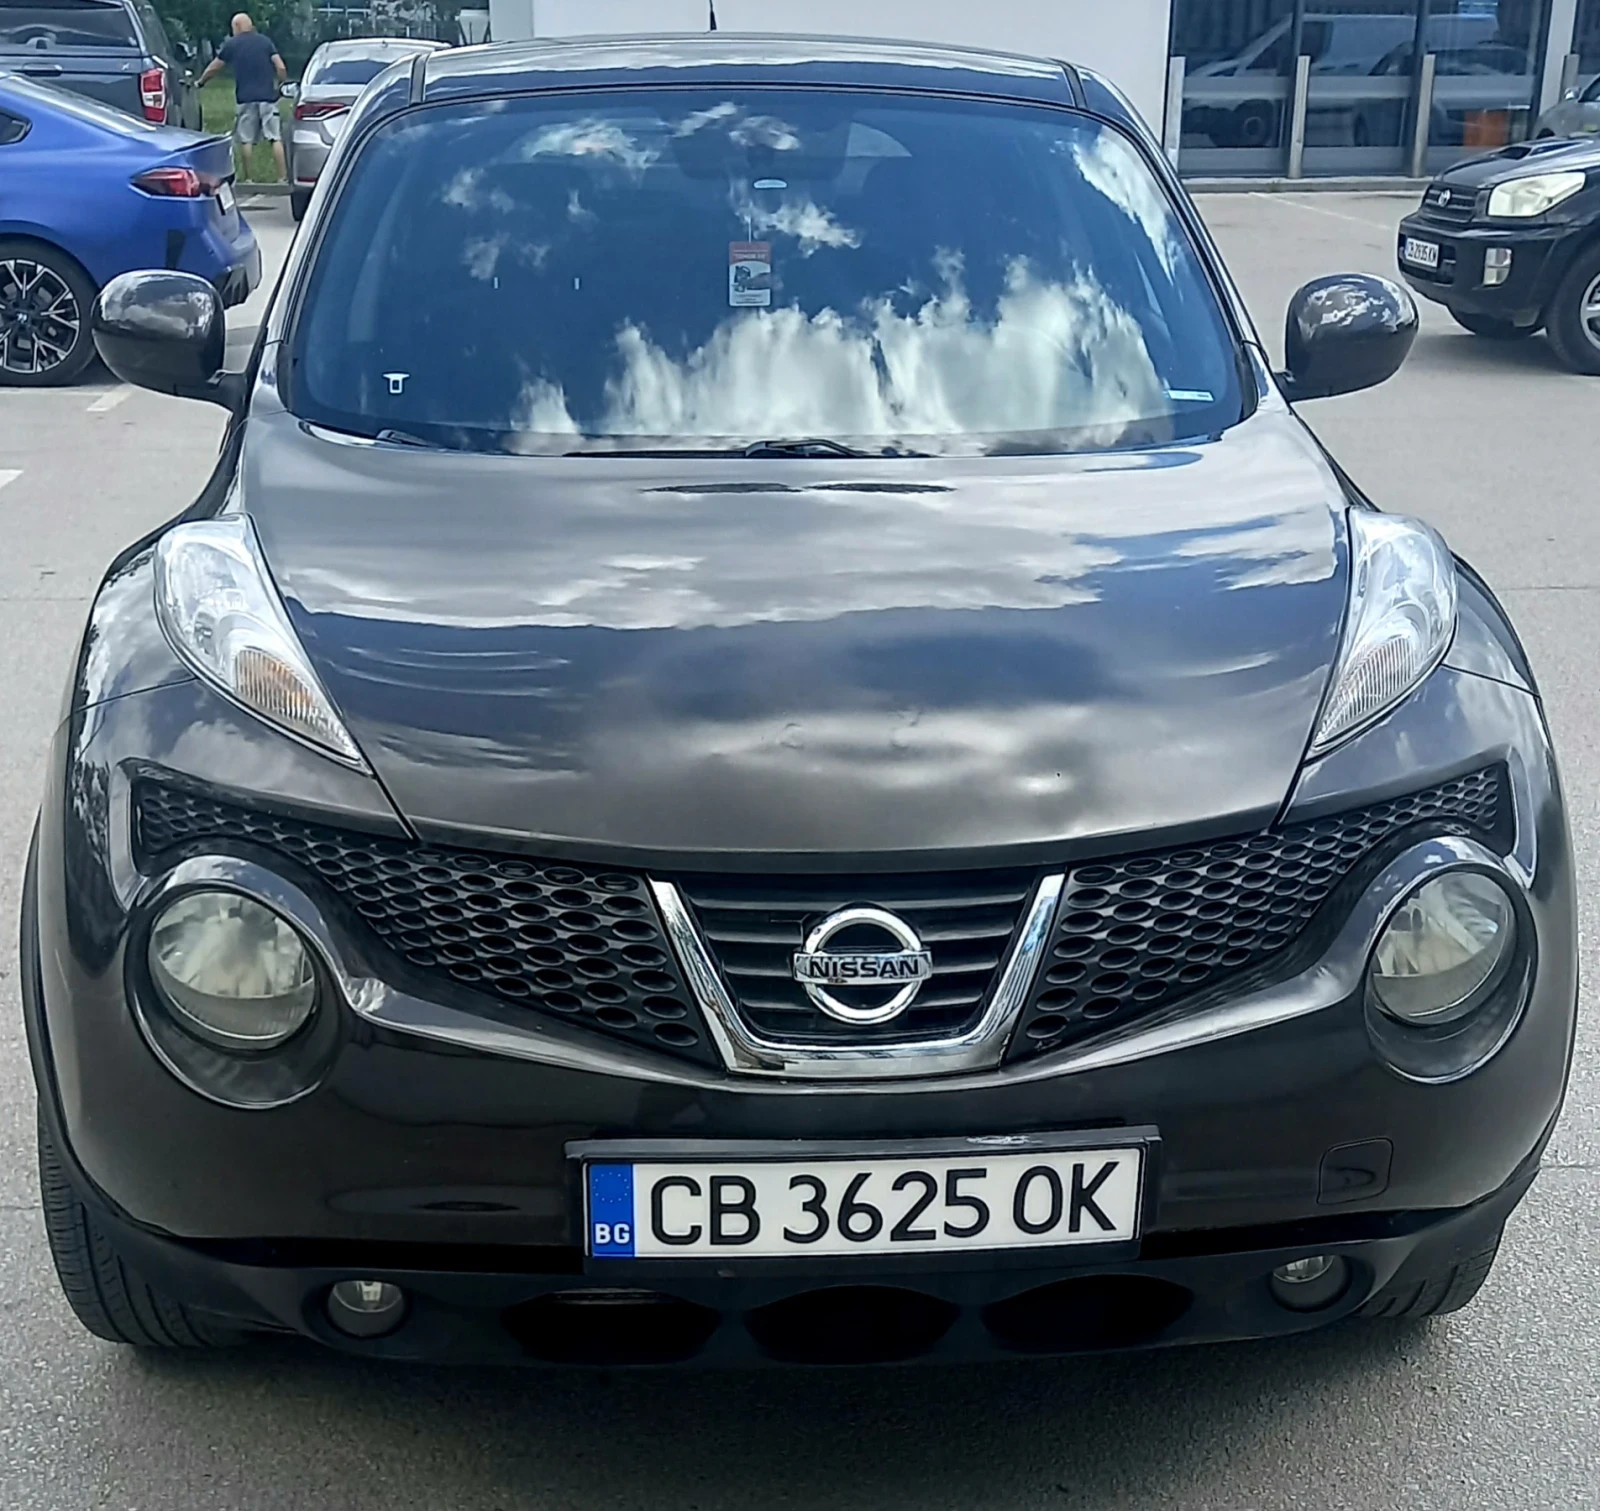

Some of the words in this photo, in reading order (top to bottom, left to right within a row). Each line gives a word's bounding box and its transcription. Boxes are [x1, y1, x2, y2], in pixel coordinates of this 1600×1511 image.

[810, 958, 919, 979] NISSAN
[651, 1175, 760, 1247] CB
[782, 1168, 990, 1243] 3625
[1012, 1161, 1120, 1234] OK
[594, 1222, 631, 1245] BG
